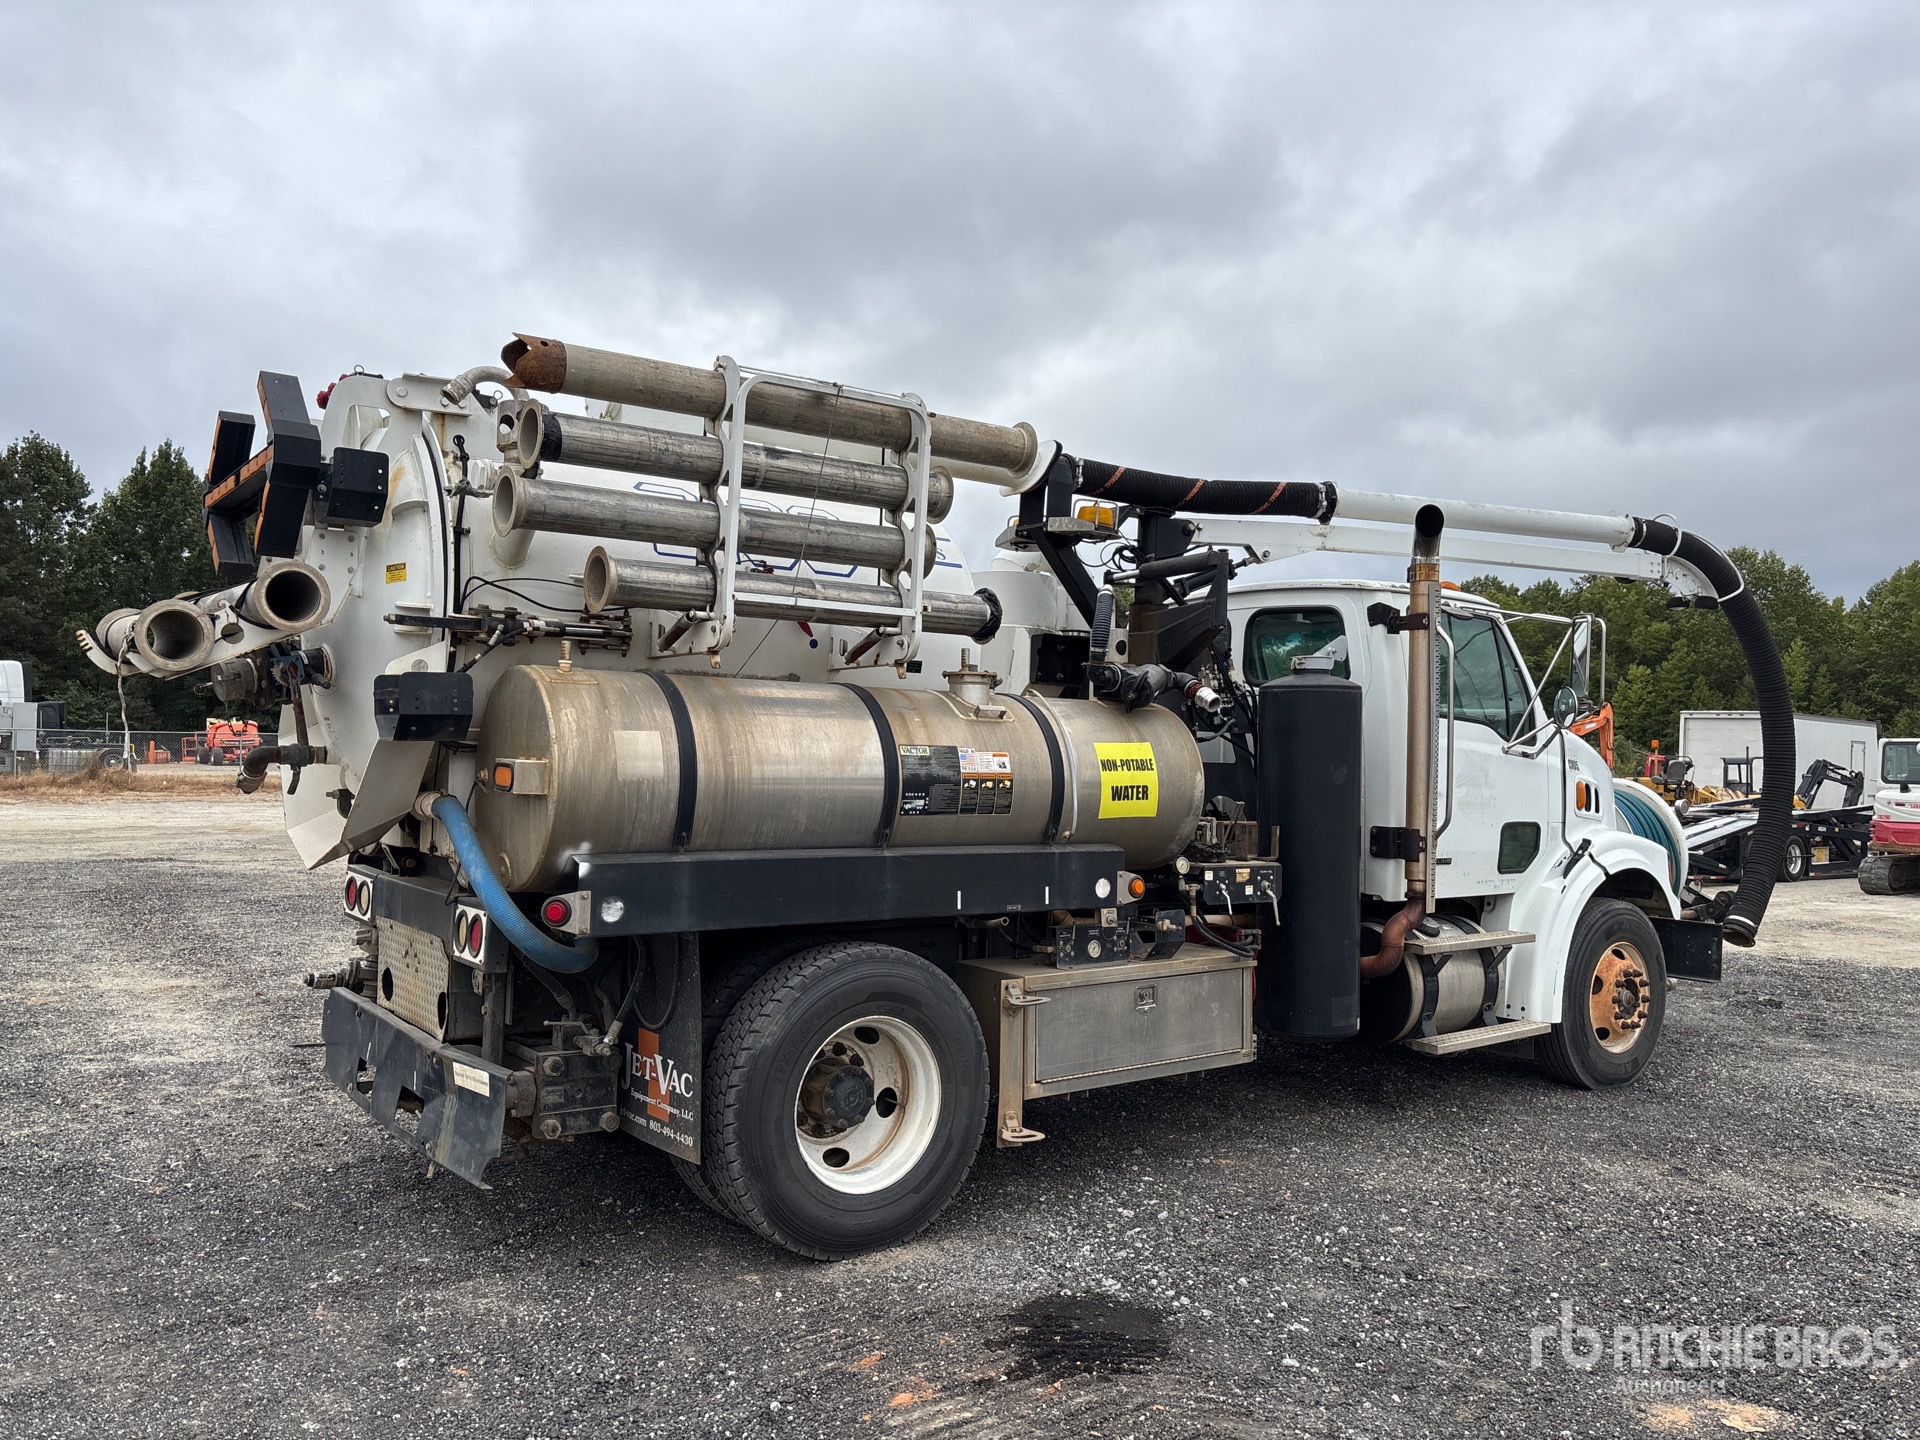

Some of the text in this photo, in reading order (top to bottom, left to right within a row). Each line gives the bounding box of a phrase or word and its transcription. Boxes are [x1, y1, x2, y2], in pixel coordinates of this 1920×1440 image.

[900, 746, 929, 755] VACTOR
[1100, 757, 1155, 773] NON-POTABLE
[1110, 784, 1149, 802] WATER
[630, 1087, 694, 1121] Equipment Company, LLC
[649, 1119, 694, 1147] 803-494-4430
